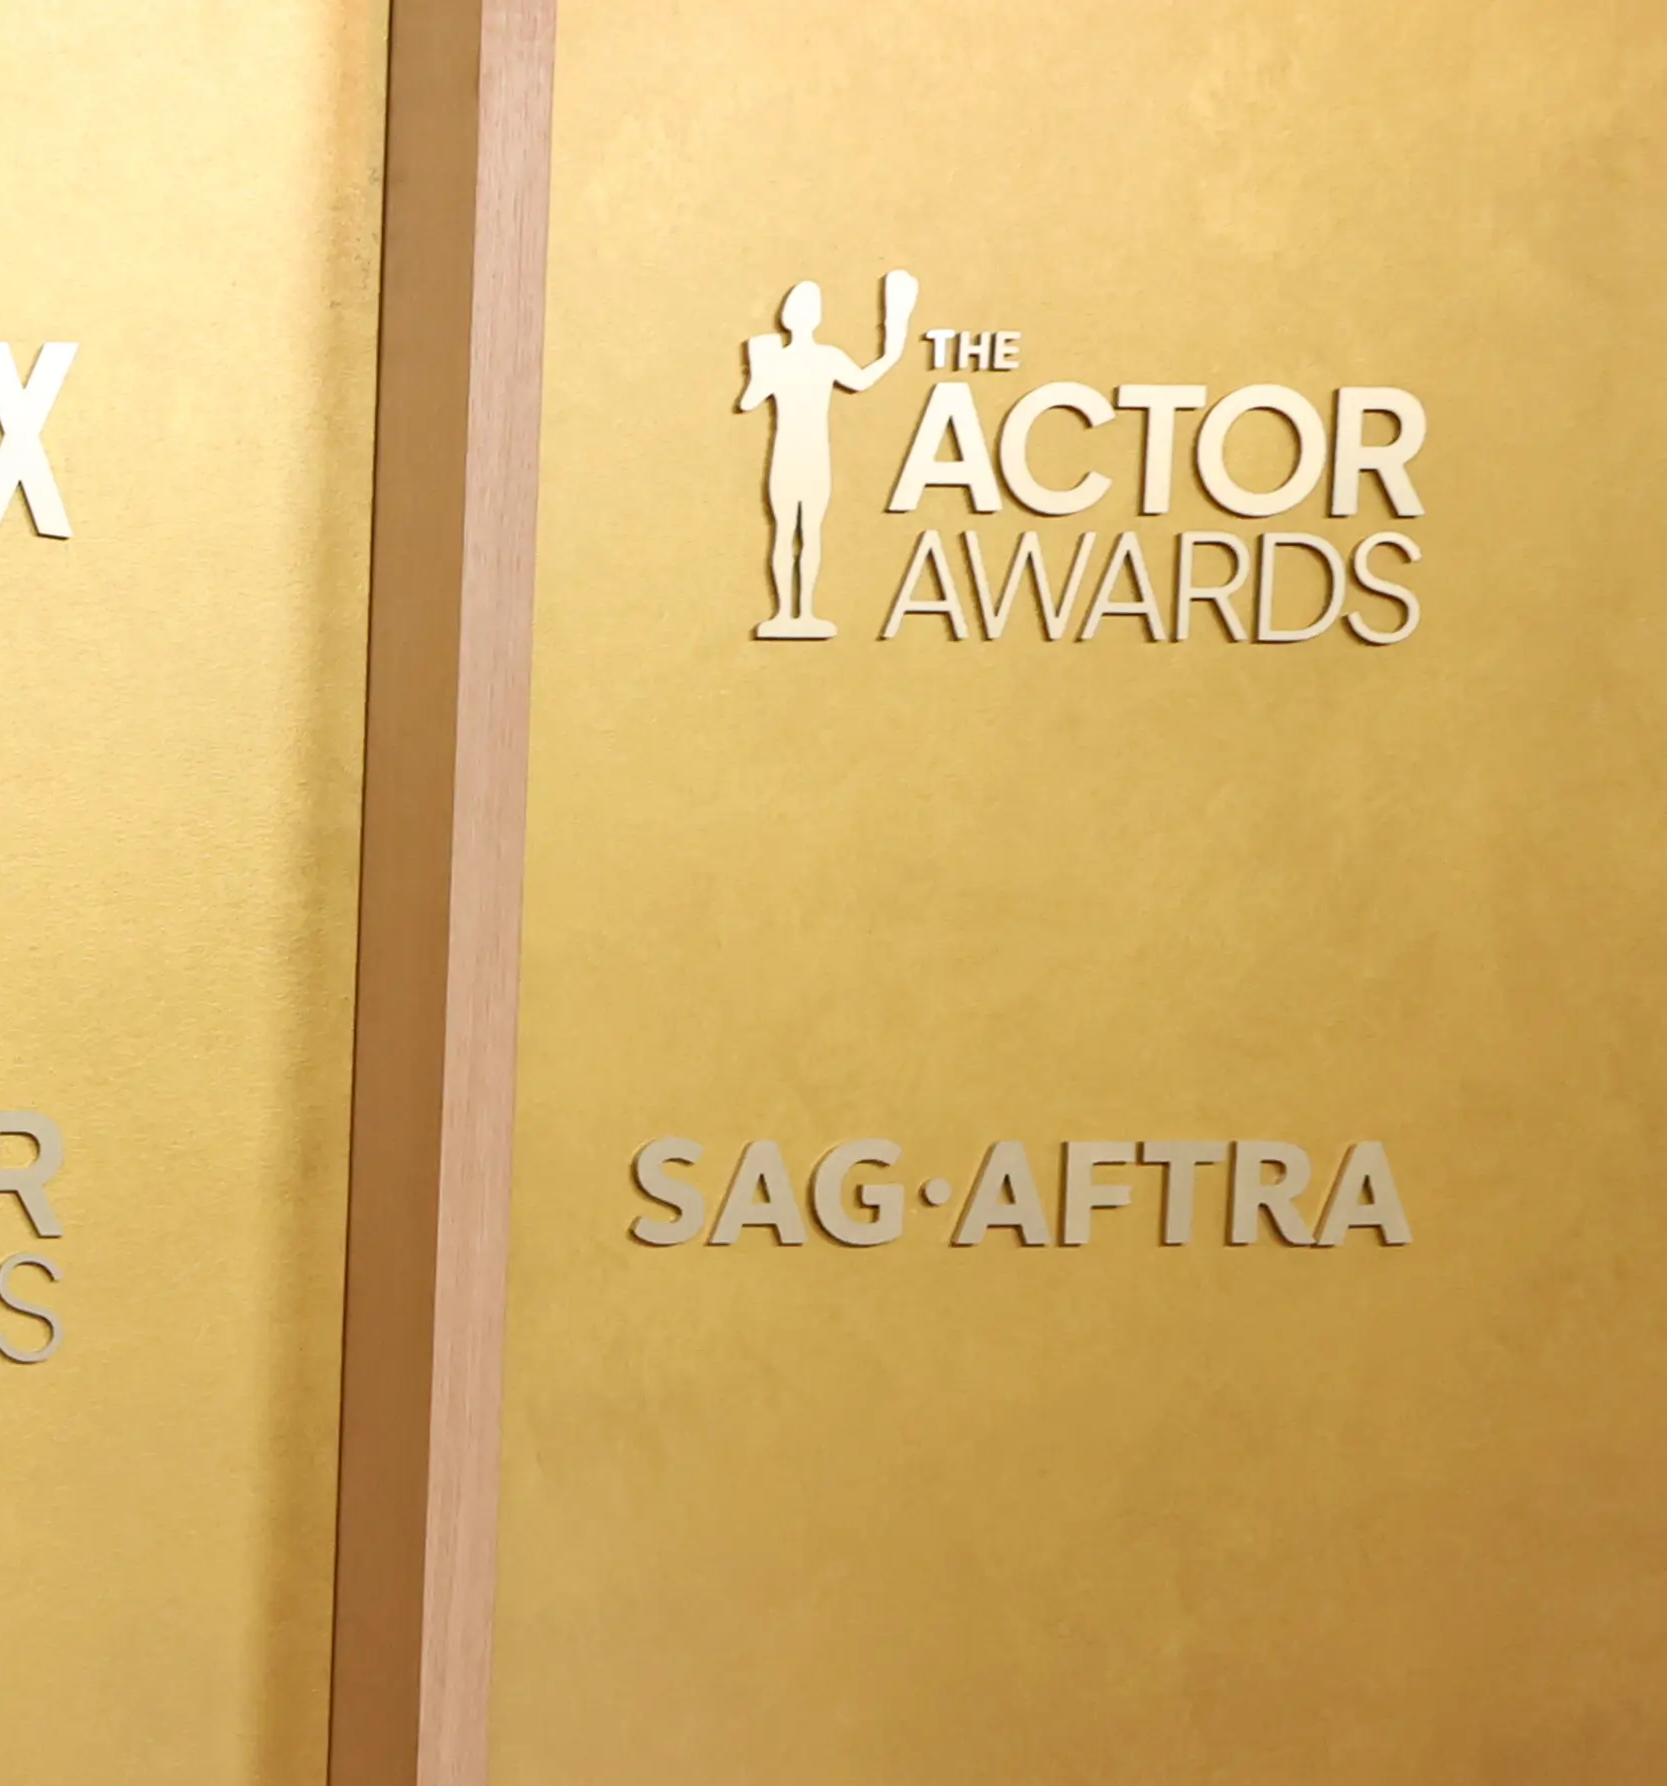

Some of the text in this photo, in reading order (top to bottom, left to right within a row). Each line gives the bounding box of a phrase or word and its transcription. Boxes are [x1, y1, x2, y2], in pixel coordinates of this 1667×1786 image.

[925, 328, 1022, 370] THE
[883, 381, 1427, 518] ACTOR
[879, 529, 1423, 645] AWARDS
